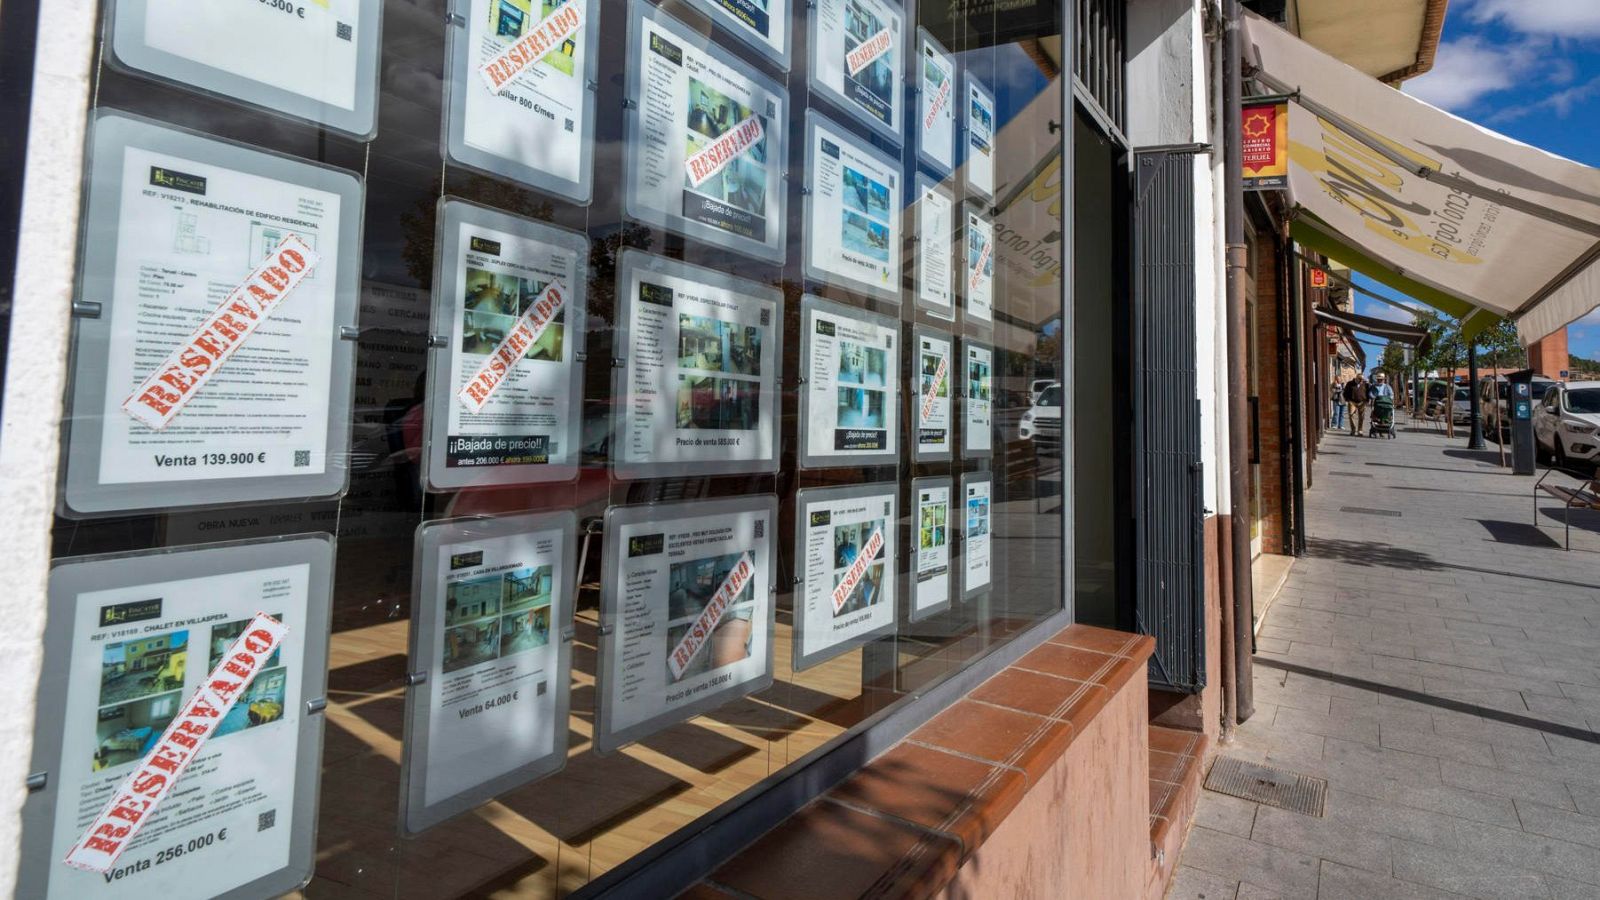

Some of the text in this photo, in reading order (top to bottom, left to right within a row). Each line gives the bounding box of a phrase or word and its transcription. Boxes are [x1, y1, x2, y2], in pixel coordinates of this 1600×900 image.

[260, 0, 305, 18] .300 €
[486, 7, 579, 87] RESERVADO
[848, 32, 890, 71] RESERVADO
[519, 96, 533, 109] 800
[533, 103, 555, 120] €/mes
[690, 119, 760, 182] RESERVADO
[190, 198, 244, 214] REHABILITACIÓN
[256, 211, 281, 221] EDIFICIO
[282, 217, 319, 229] RESIDENCIAL
[137, 248, 306, 417] RESERVADO
[466, 288, 561, 405] RESERVADO
[1518, 384, 1526, 394] P
[450, 438, 542, 454] ¡¡Bajada de precio!!
[676, 437, 694, 446] Precio
[695, 437, 702, 446] de
[703, 437, 717, 446] venta
[154, 452, 266, 467] Venta 139.900 €
[458, 457, 475, 466] antes
[198, 521, 226, 531] OBRA
[228, 518, 261, 528] NUEVA
[834, 532, 881, 608] RESERVADO
[144, 621, 173, 633] CHALET
[175, 619, 185, 627] EN
[187, 613, 228, 626] VILLASPESA
[673, 561, 749, 670] RESERVADO
[459, 690, 519, 719] Venta 64.000 €
[83, 629, 273, 856] RESERVADO
[104, 827, 228, 883] Venta 256.000 €
